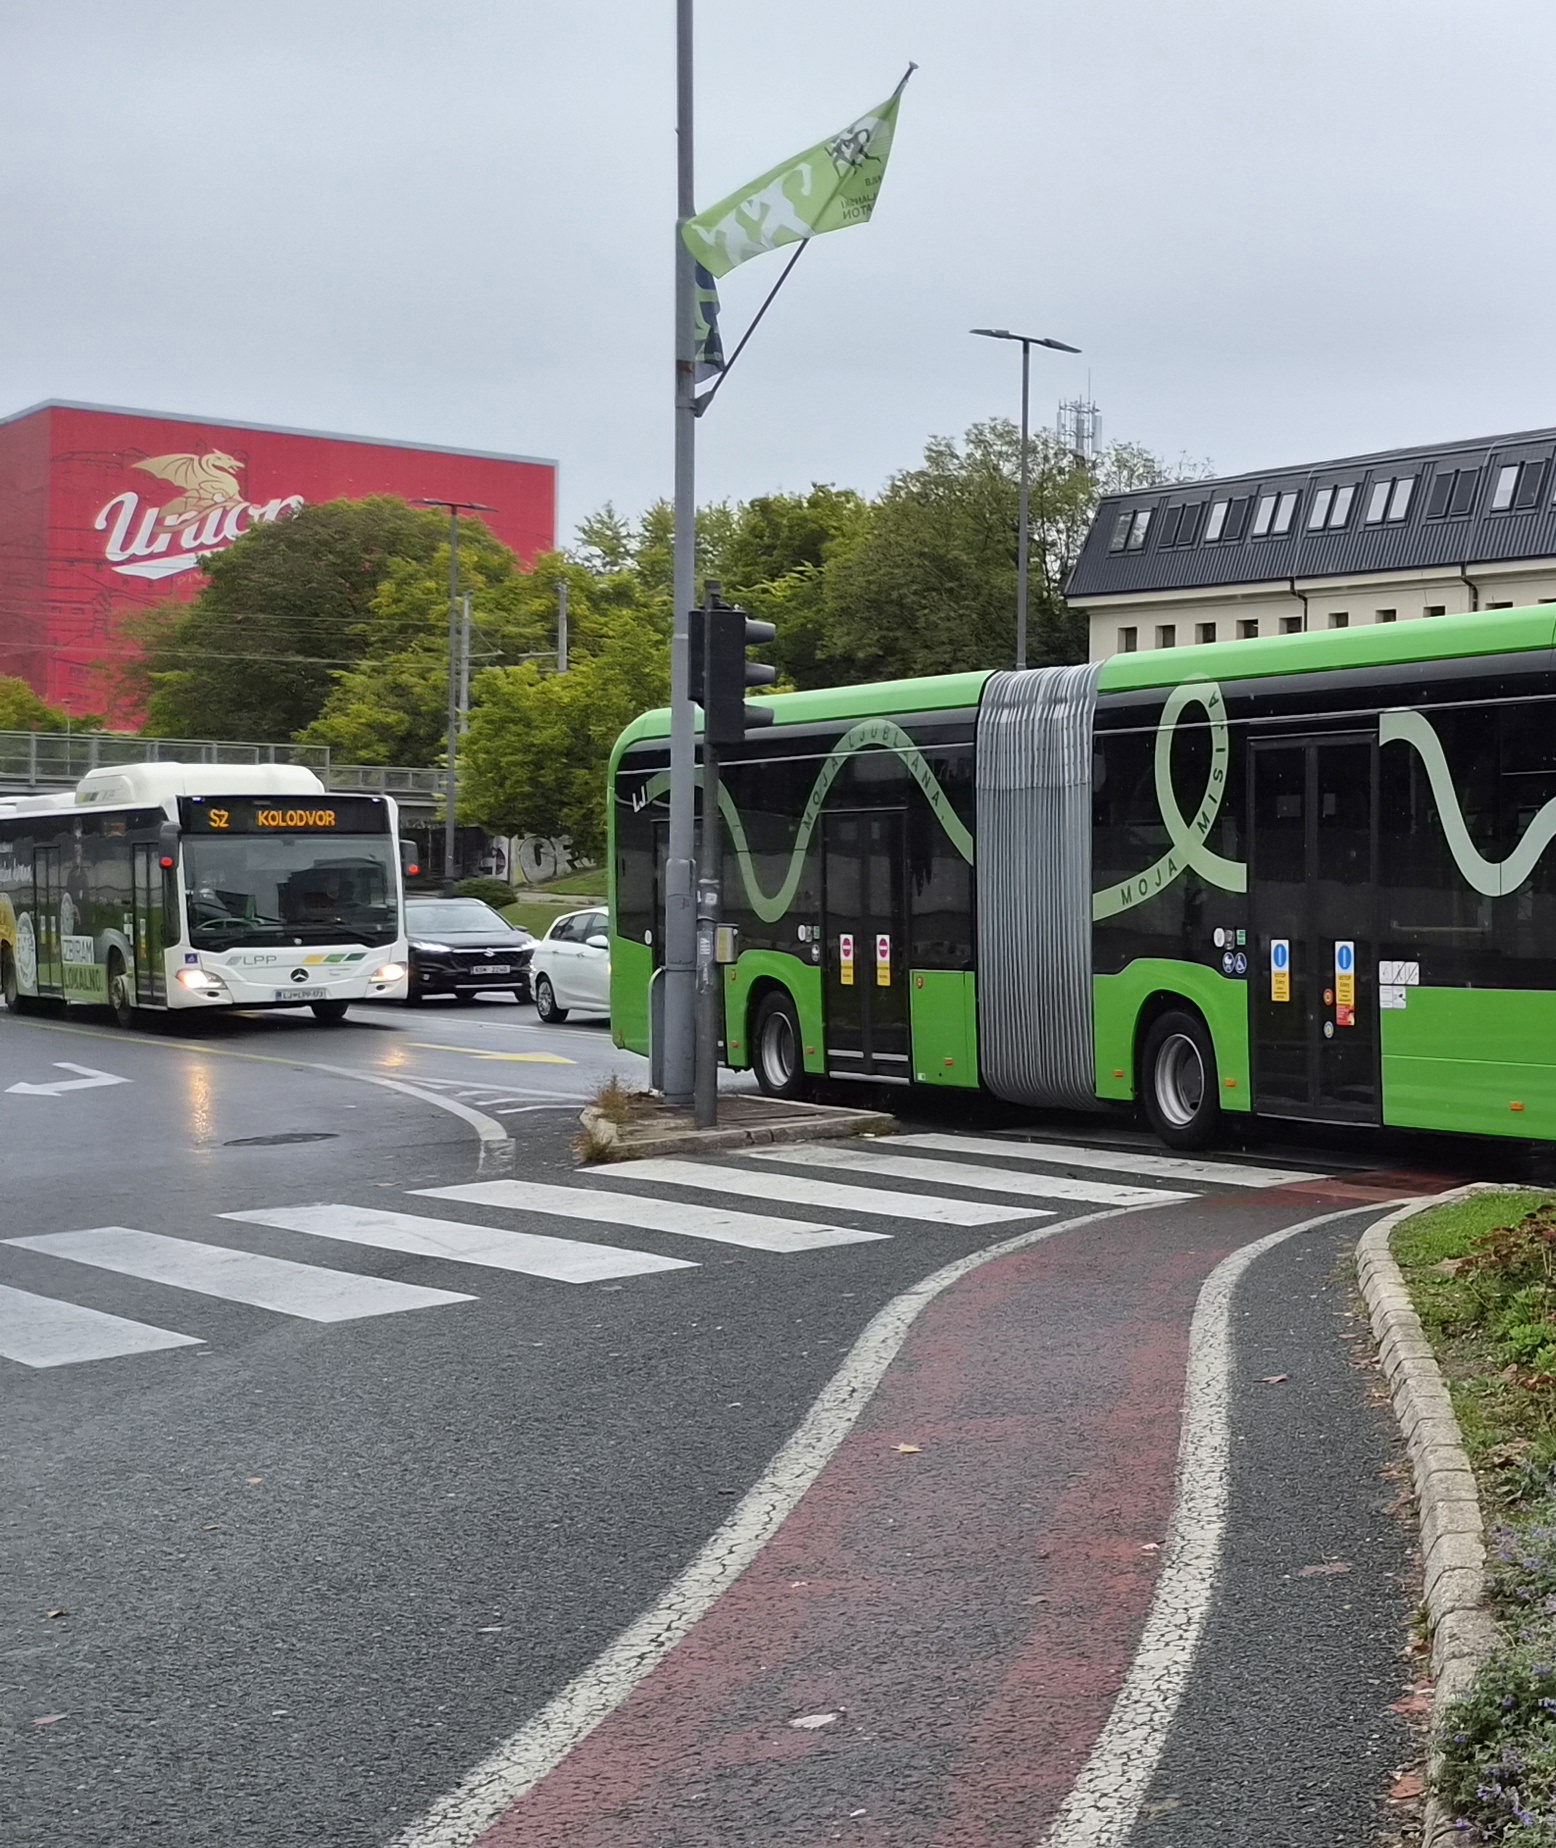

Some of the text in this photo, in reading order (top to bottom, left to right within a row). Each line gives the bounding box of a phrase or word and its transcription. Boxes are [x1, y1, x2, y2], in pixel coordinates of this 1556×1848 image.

[802, 756, 838, 831] MOJA
[1121, 691, 1226, 905] MOJA MISIJA
[258, 809, 336, 827] KOLODVOR
[243, 955, 278, 966] LPP
